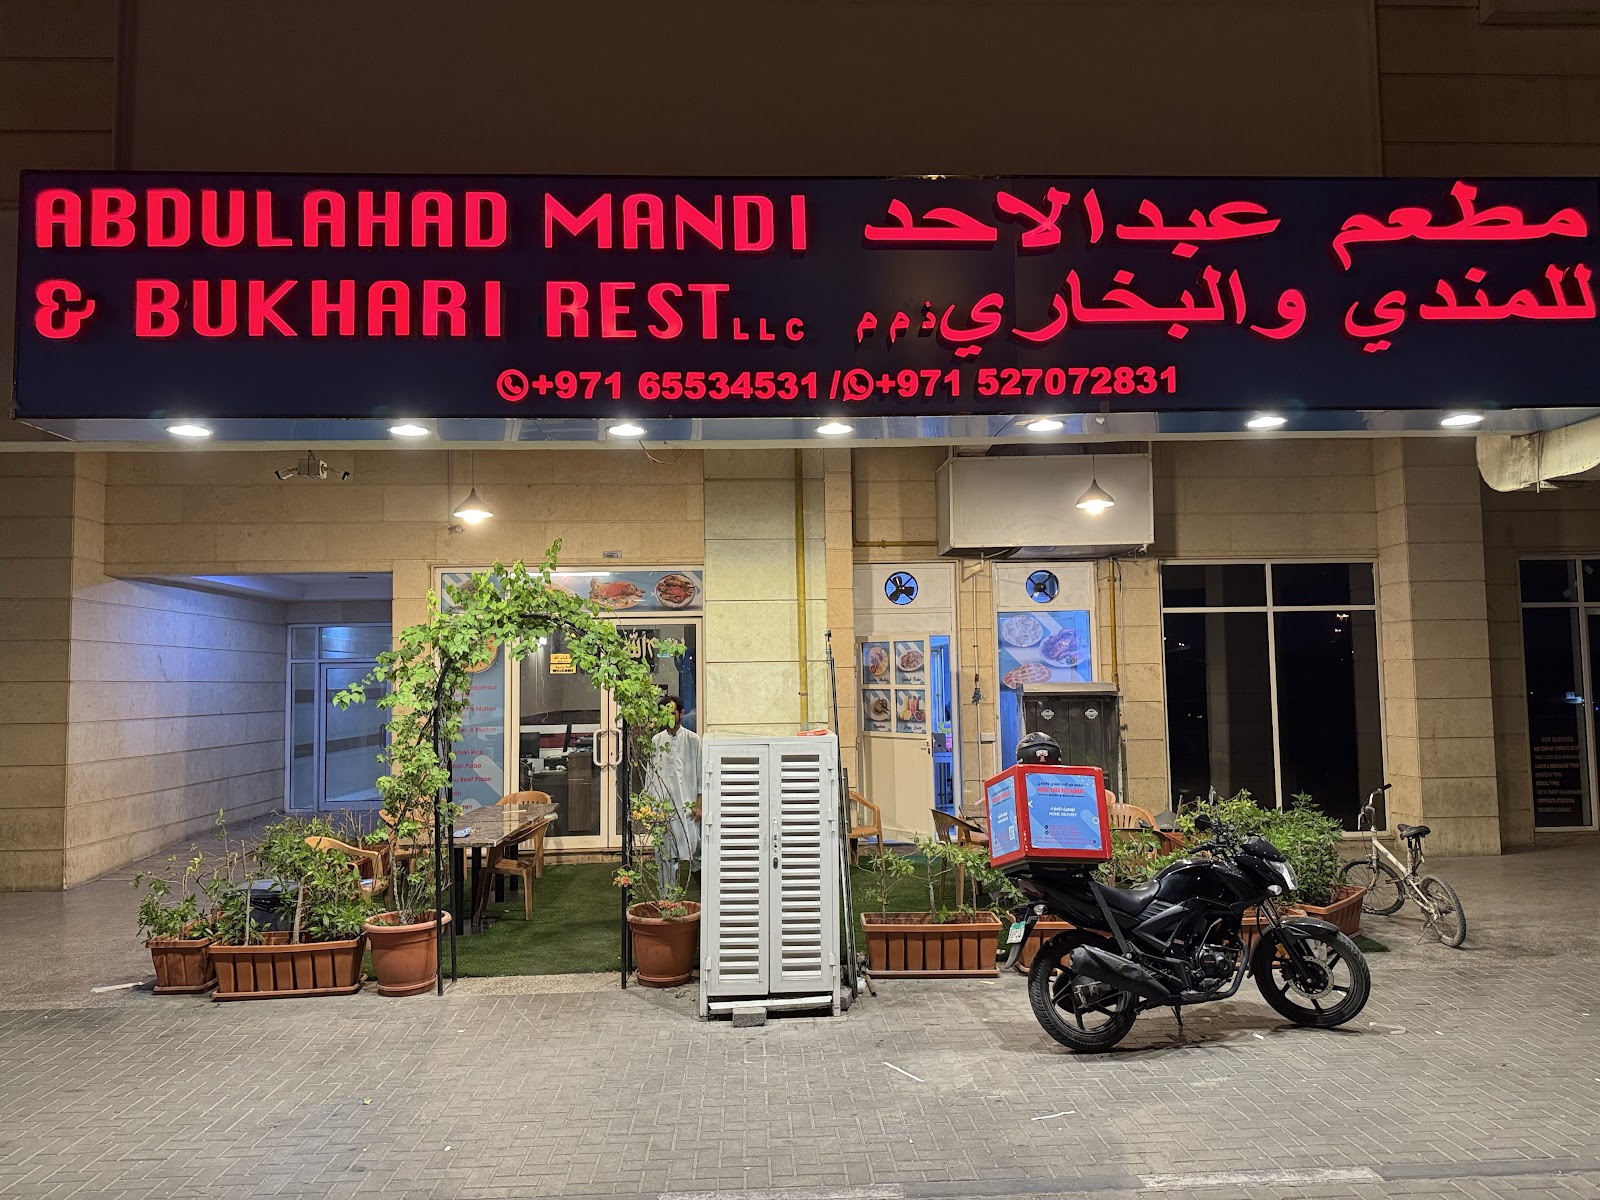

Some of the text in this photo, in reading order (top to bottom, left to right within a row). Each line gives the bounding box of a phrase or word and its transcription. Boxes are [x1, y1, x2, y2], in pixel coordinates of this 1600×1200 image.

[35, 188, 807, 252] ABDULAHAD MANDI
[1332, 181, 1588, 270] مطعم
[34, 279, 96, 339] &
[135, 279, 501, 338] BUKHARI
[546, 281, 730, 341] REST
[939, 264, 1307, 358] والبخاري
[1344, 263, 1596, 354] للمندي
[532, 368, 621, 400] +971
[638, 368, 817, 400] 65534531
[875, 368, 960, 400] +971
[978, 365, 1176, 396] 527072831
